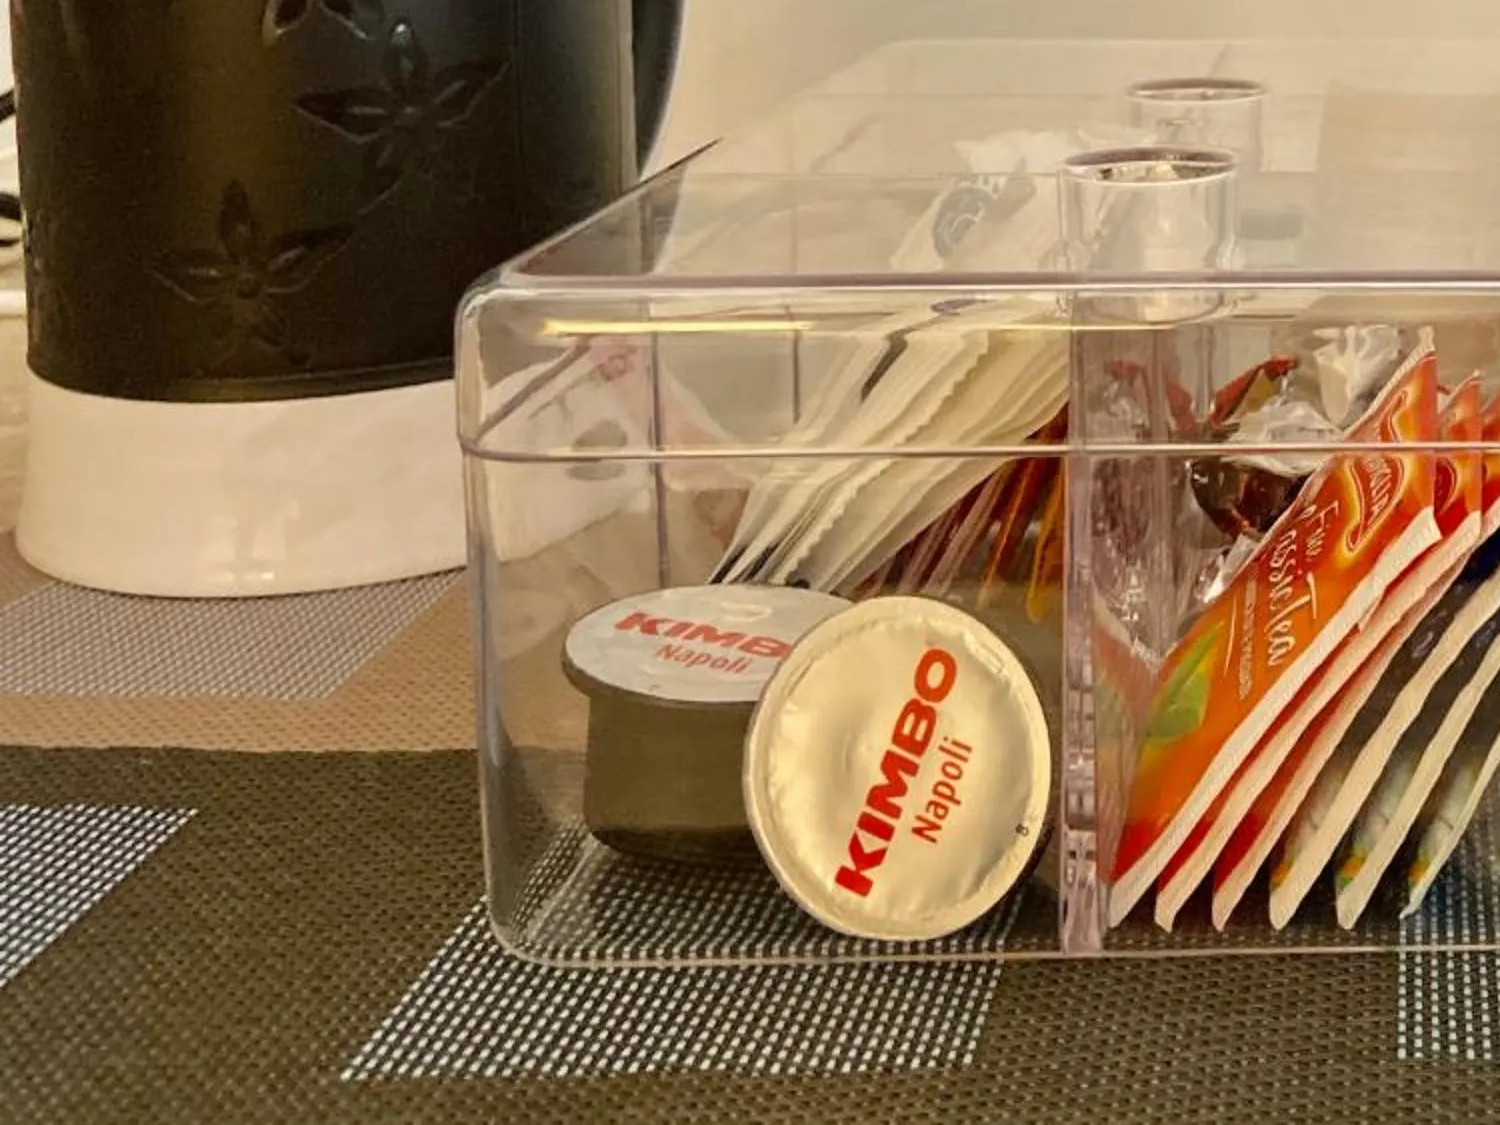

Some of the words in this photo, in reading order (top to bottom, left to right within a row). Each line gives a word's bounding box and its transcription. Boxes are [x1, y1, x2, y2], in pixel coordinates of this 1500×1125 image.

[615, 610, 794, 659] KIMB
[654, 643, 752, 674] Napoli
[834, 648, 958, 898] KIMBO
[911, 736, 973, 844] Napoli
